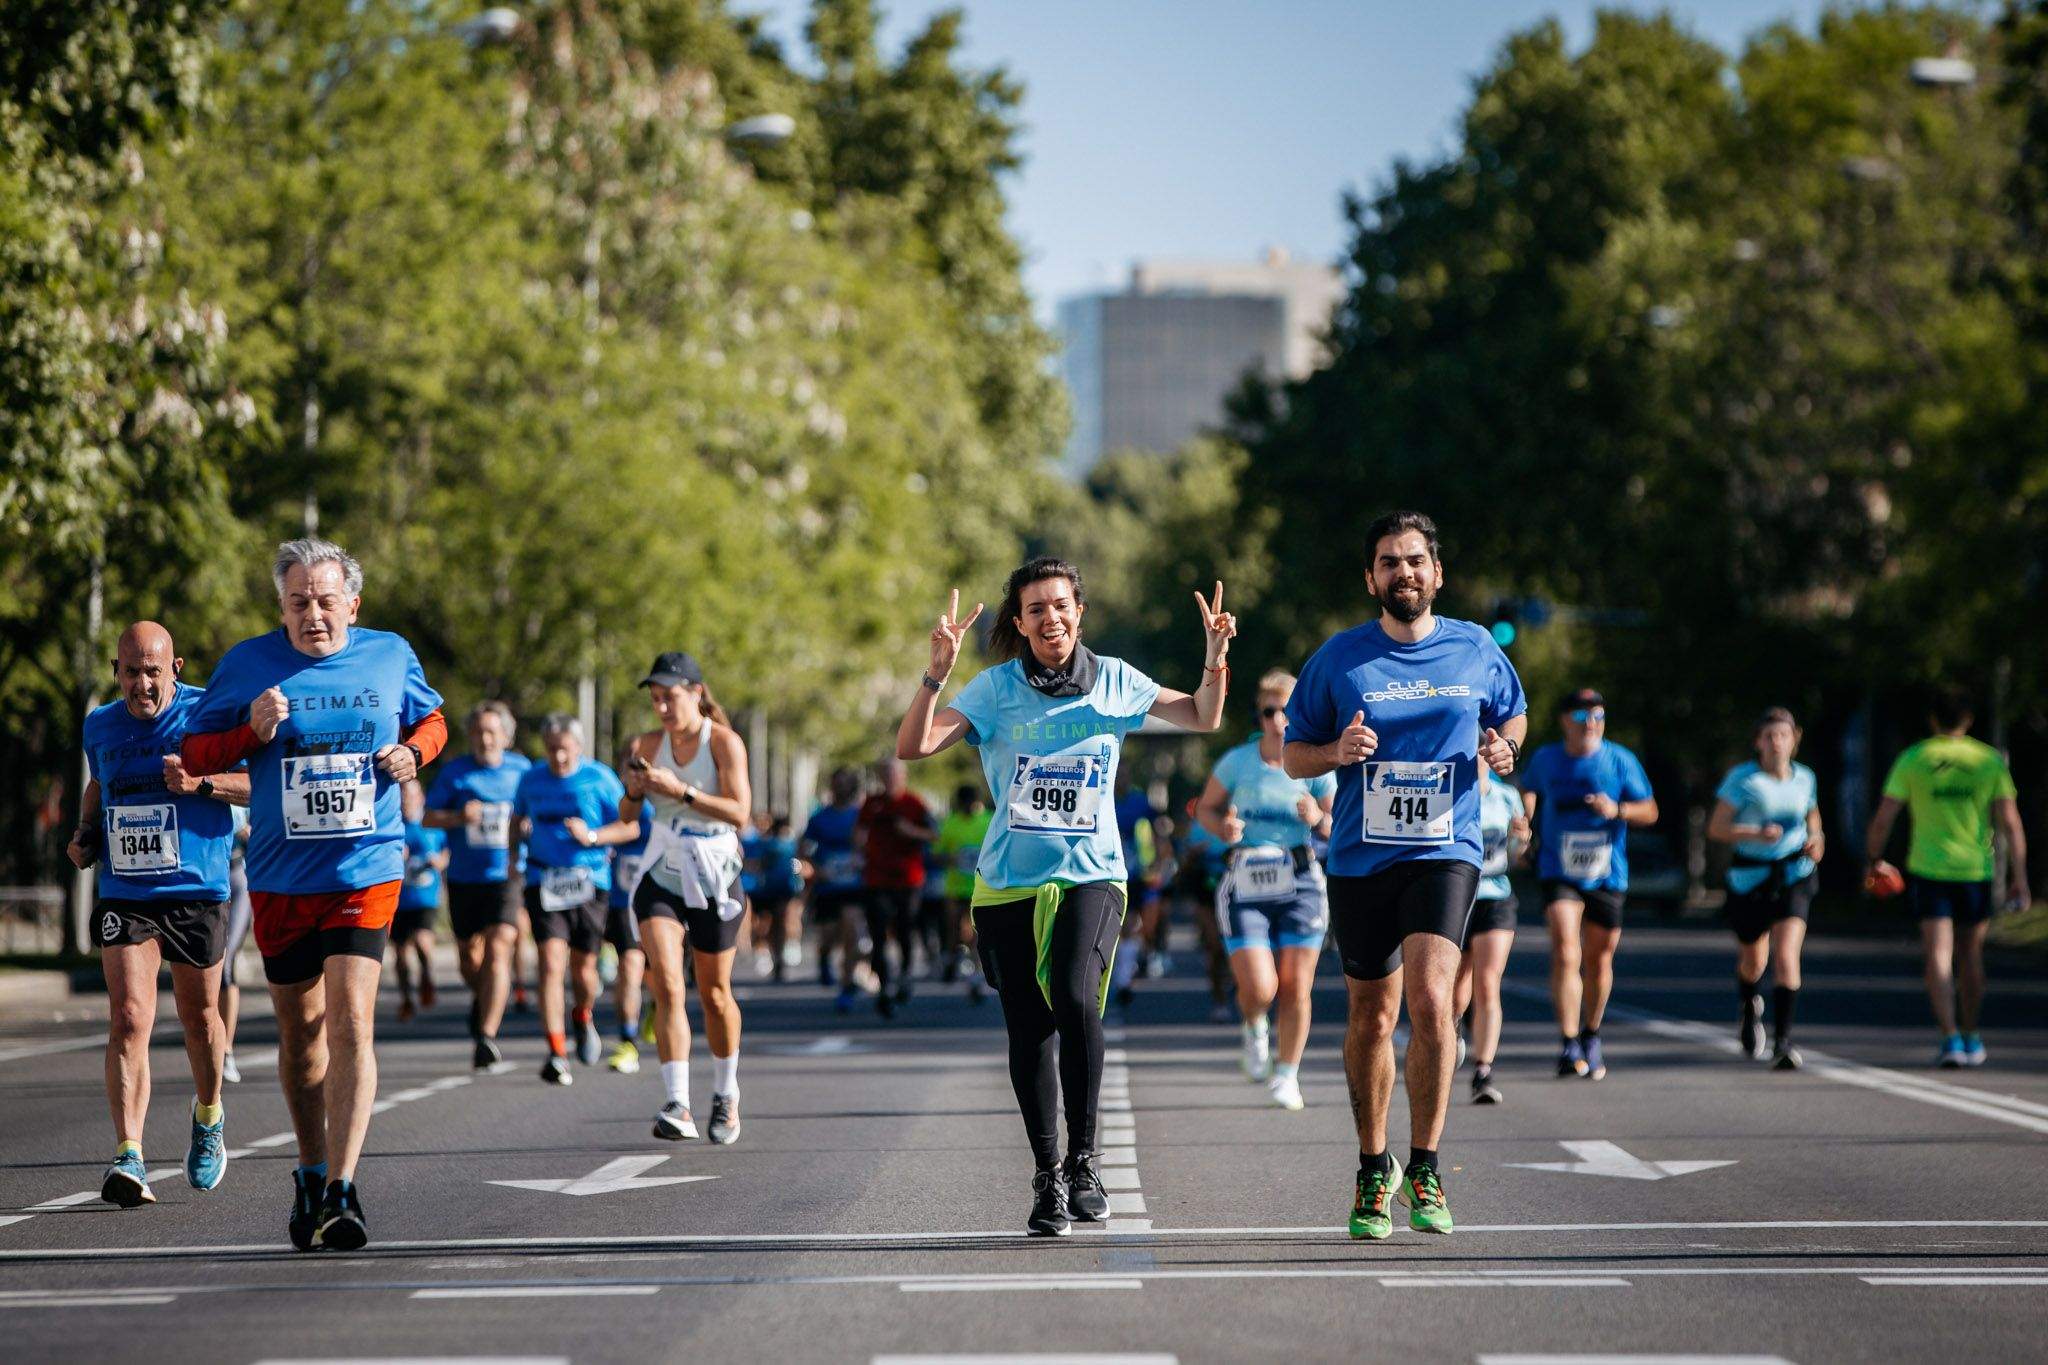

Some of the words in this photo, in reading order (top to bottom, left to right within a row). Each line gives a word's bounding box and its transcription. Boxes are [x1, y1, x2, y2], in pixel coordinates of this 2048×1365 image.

[1387, 680, 1430, 691] CLUB
[288, 694, 380, 712] ECIMAS
[303, 731, 373, 744] BOMBEROS
[1011, 722, 1116, 740] DECIMAS
[1041, 766, 1085, 774] BOMBEROS
[308, 780, 356, 789] DECIMAS
[1035, 779, 1083, 788] DECIMAS
[1389, 786, 1436, 795] DECIMAS
[303, 789, 356, 815] 1957
[1032, 787, 1077, 813] 998
[1388, 796, 1429, 824] 414
[120, 834, 162, 855] 1344
